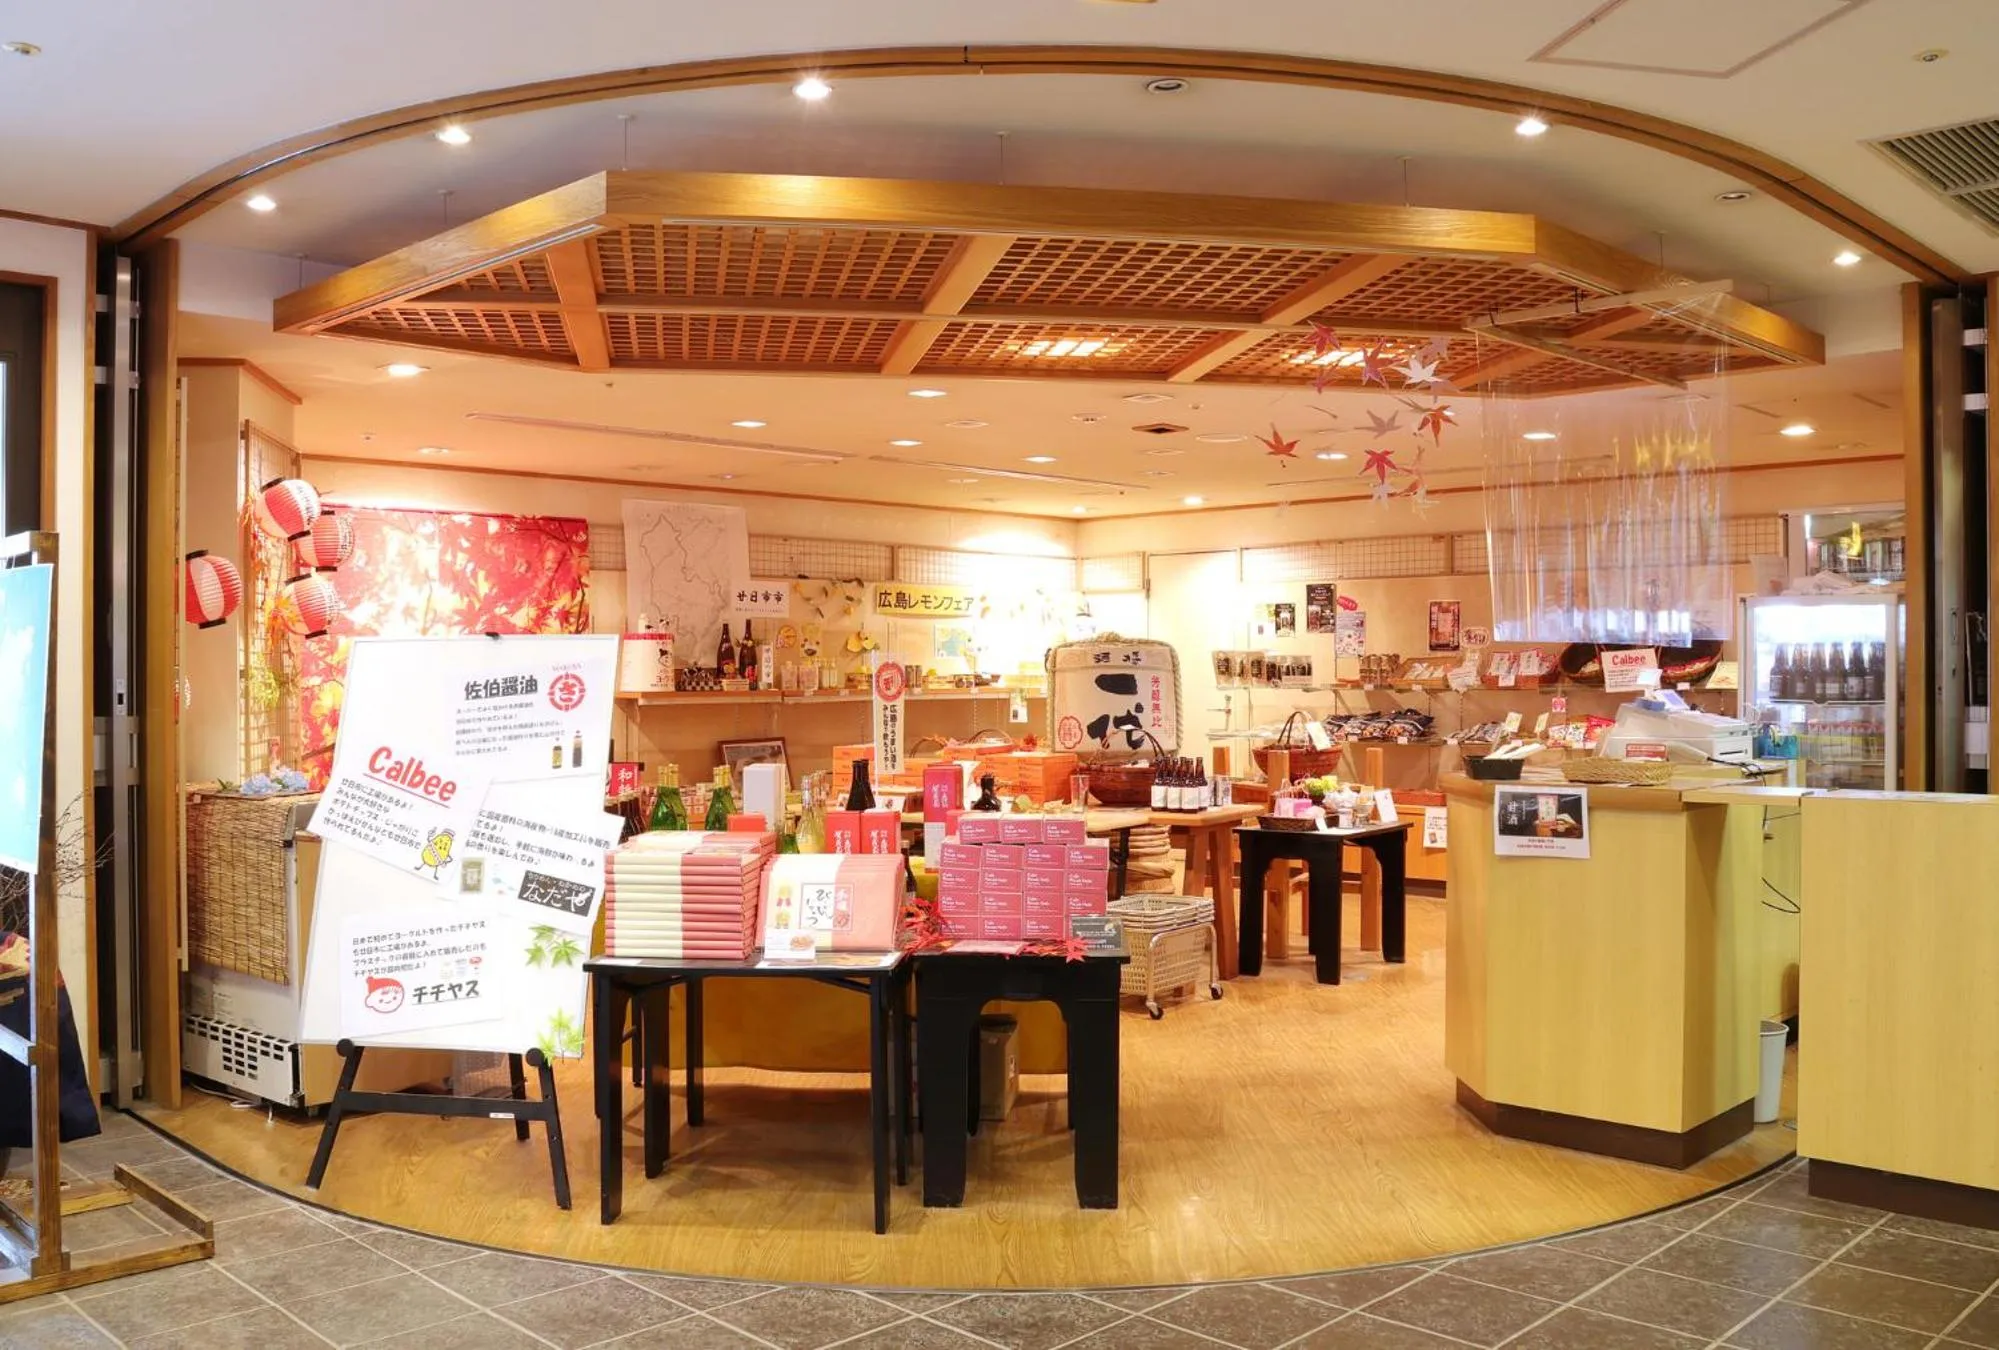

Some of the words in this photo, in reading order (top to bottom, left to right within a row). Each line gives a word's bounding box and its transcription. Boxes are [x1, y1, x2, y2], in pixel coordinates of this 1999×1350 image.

[736, 589, 784, 604] 廿日市市
[877, 589, 974, 613] 広島レモンフェア
[464, 674, 538, 701] 佐伯醤油
[368, 746, 457, 802] Calbee
[522, 881, 593, 912] なだや
[412, 980, 480, 1004] チチヤス
